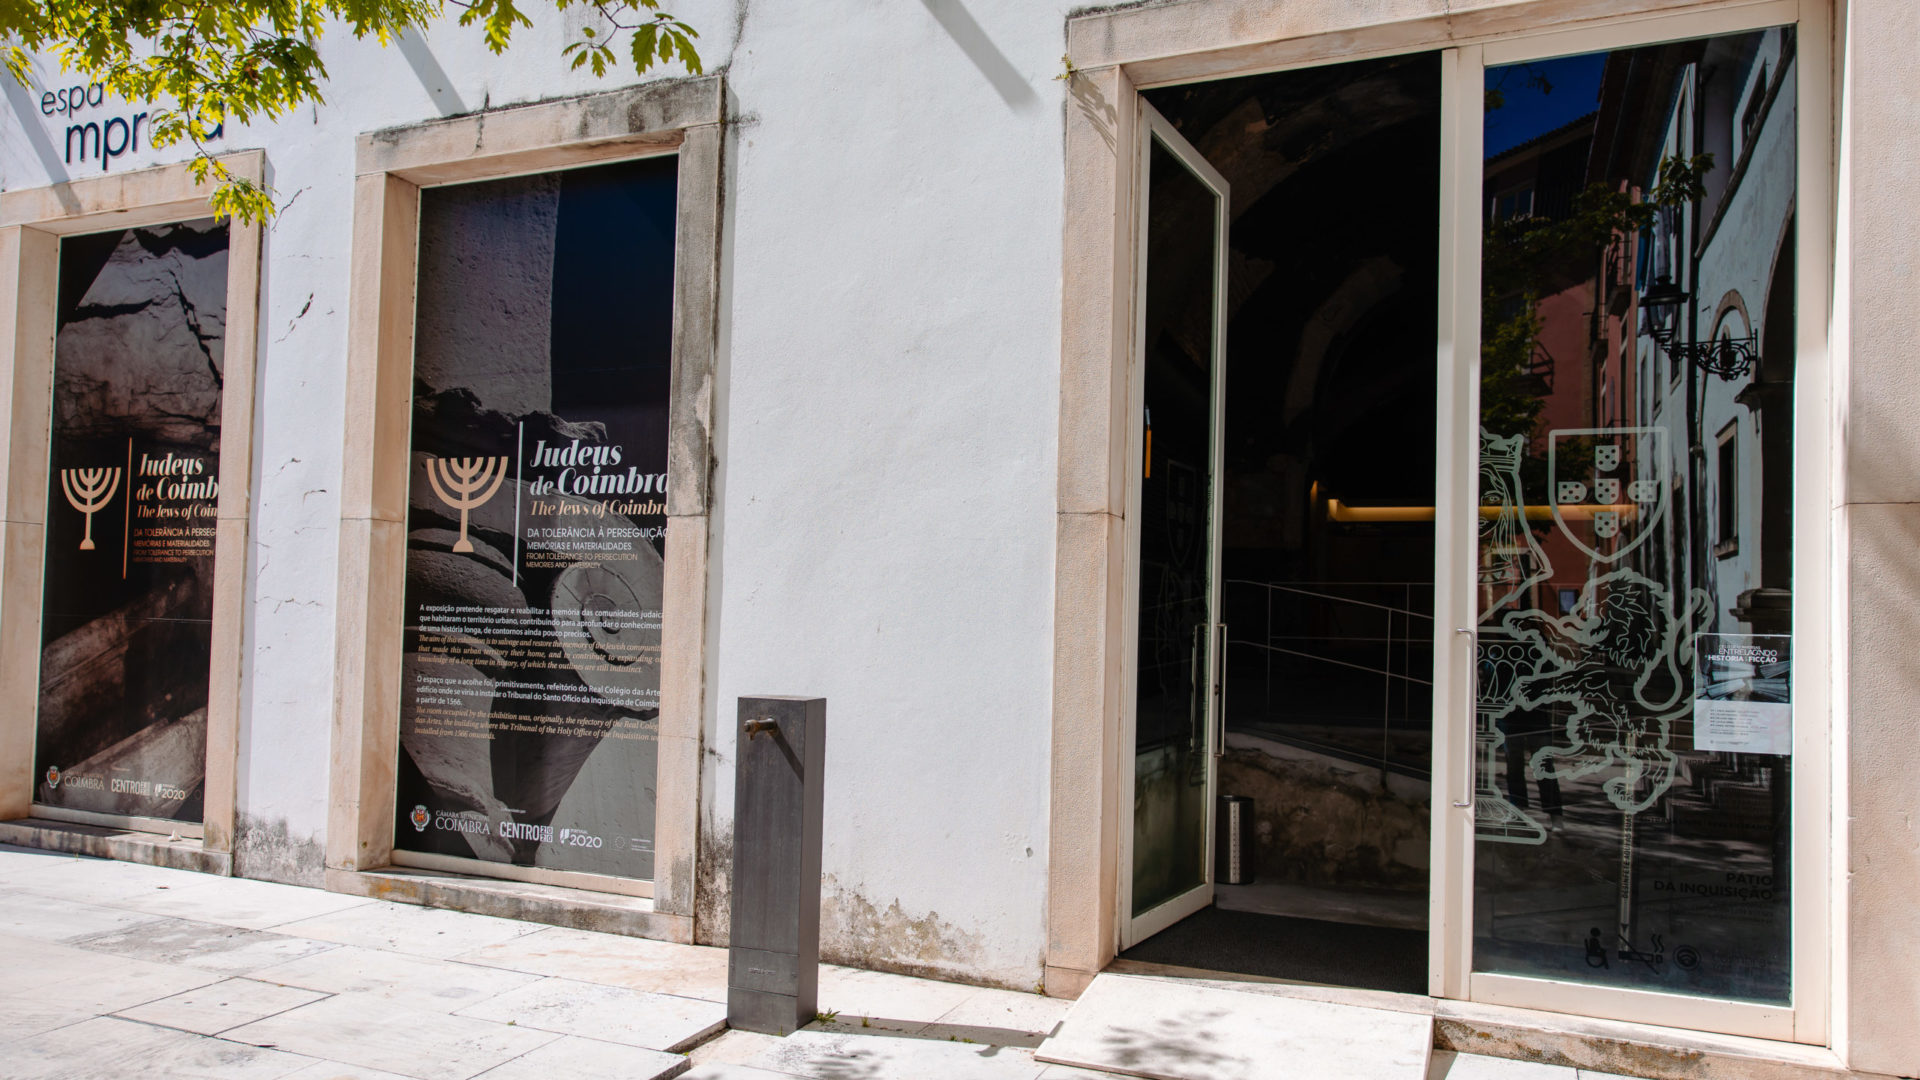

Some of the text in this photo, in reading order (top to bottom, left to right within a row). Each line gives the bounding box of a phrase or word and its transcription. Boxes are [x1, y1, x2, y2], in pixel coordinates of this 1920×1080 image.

[41, 82, 104, 120] espa
[530, 439, 623, 467] Judeus
[138, 452, 204, 477] Judeus
[136, 483, 154, 501] de
[530, 475, 554, 496] de
[137, 504, 156, 518] The
[156, 504, 180, 518] Jews
[181, 503, 193, 521] of
[531, 500, 556, 516] The
[558, 500, 589, 516] Jews
[592, 500, 609, 519] of
[134, 528, 143, 537] DA
[144, 526, 183, 537] TOLERÂNCIA
[527, 528, 539, 538] DA
[542, 526, 595, 538] TOLERÂNCIA
[598, 526, 604, 538] À
[527, 540, 632, 551] MEMÓRIAS E MATERIALIDADES
[526, 552, 638, 561] FROM TOLERANCE TO PERSECUTION
[426, 605, 455, 614] exposição
[456, 605, 483, 614] pretende
[484, 606, 509, 615] resgatar
[516, 606, 544, 614] reabilitar
[552, 608, 580, 616] memória
[581, 608, 593, 616] das
[595, 609, 639, 618] comunidades
[495, 617, 518, 625] urbano,
[520, 617, 560, 626] contribuindo
[561, 619, 575, 627] para
[576, 619, 613, 628] aprofundar
[441, 625, 463, 633] história
[464, 626, 483, 634] longa,
[524, 627, 541, 635] ainda
[542, 630, 563, 638] pouco
[564, 630, 591, 638] precisos.
[419, 634, 428, 642] The
[519, 638, 532, 646] and
[510, 648, 525, 656] their
[548, 661, 557, 669] the
[417, 675, 422, 683] O
[462, 678, 483, 686] acolhe
[484, 679, 494, 687] foi,
[495, 680, 545, 690] primitivamente,
[546, 683, 577, 692] refeitório
[578, 684, 587, 692] do
[589, 685, 603, 693] Real
[605, 685, 630, 696] Colégio
[632, 687, 644, 695] das
[421, 697, 437, 705] partir
[479, 688, 501, 697] instalar
[507, 691, 533, 699] Tribunal
[533, 692, 542, 700] do
[543, 693, 560, 701] Santo
[562, 694, 581, 703] Ofício
[581, 695, 590, 703] da
[590, 695, 624, 707] Inquisição
[625, 698, 634, 706] de
[533, 715, 564, 725] originally,
[565, 716, 575, 724] the
[604, 718, 612, 728] of
[624, 720, 639, 728] Real
[499, 722, 509, 730] the
[510, 723, 538, 732] Tribunal
[538, 726, 545, 735] of
[546, 726, 556, 734] the
[557, 727, 572, 737] Holy
[573, 727, 591, 738] Office
[593, 728, 600, 738] of
[63, 775, 104, 791] COIMBRA
[111, 779, 140, 795] CENTRO
[162, 788, 185, 801] 2020
[436, 809, 458, 818] CÂMARA
[435, 816, 491, 835] COIMBRA
[499, 821, 540, 841] CENTRO
[570, 834, 603, 848] 2020
[1726, 871, 1773, 886] PÁTIO
[1654, 880, 1773, 901] DA INQUISIÇÃO
